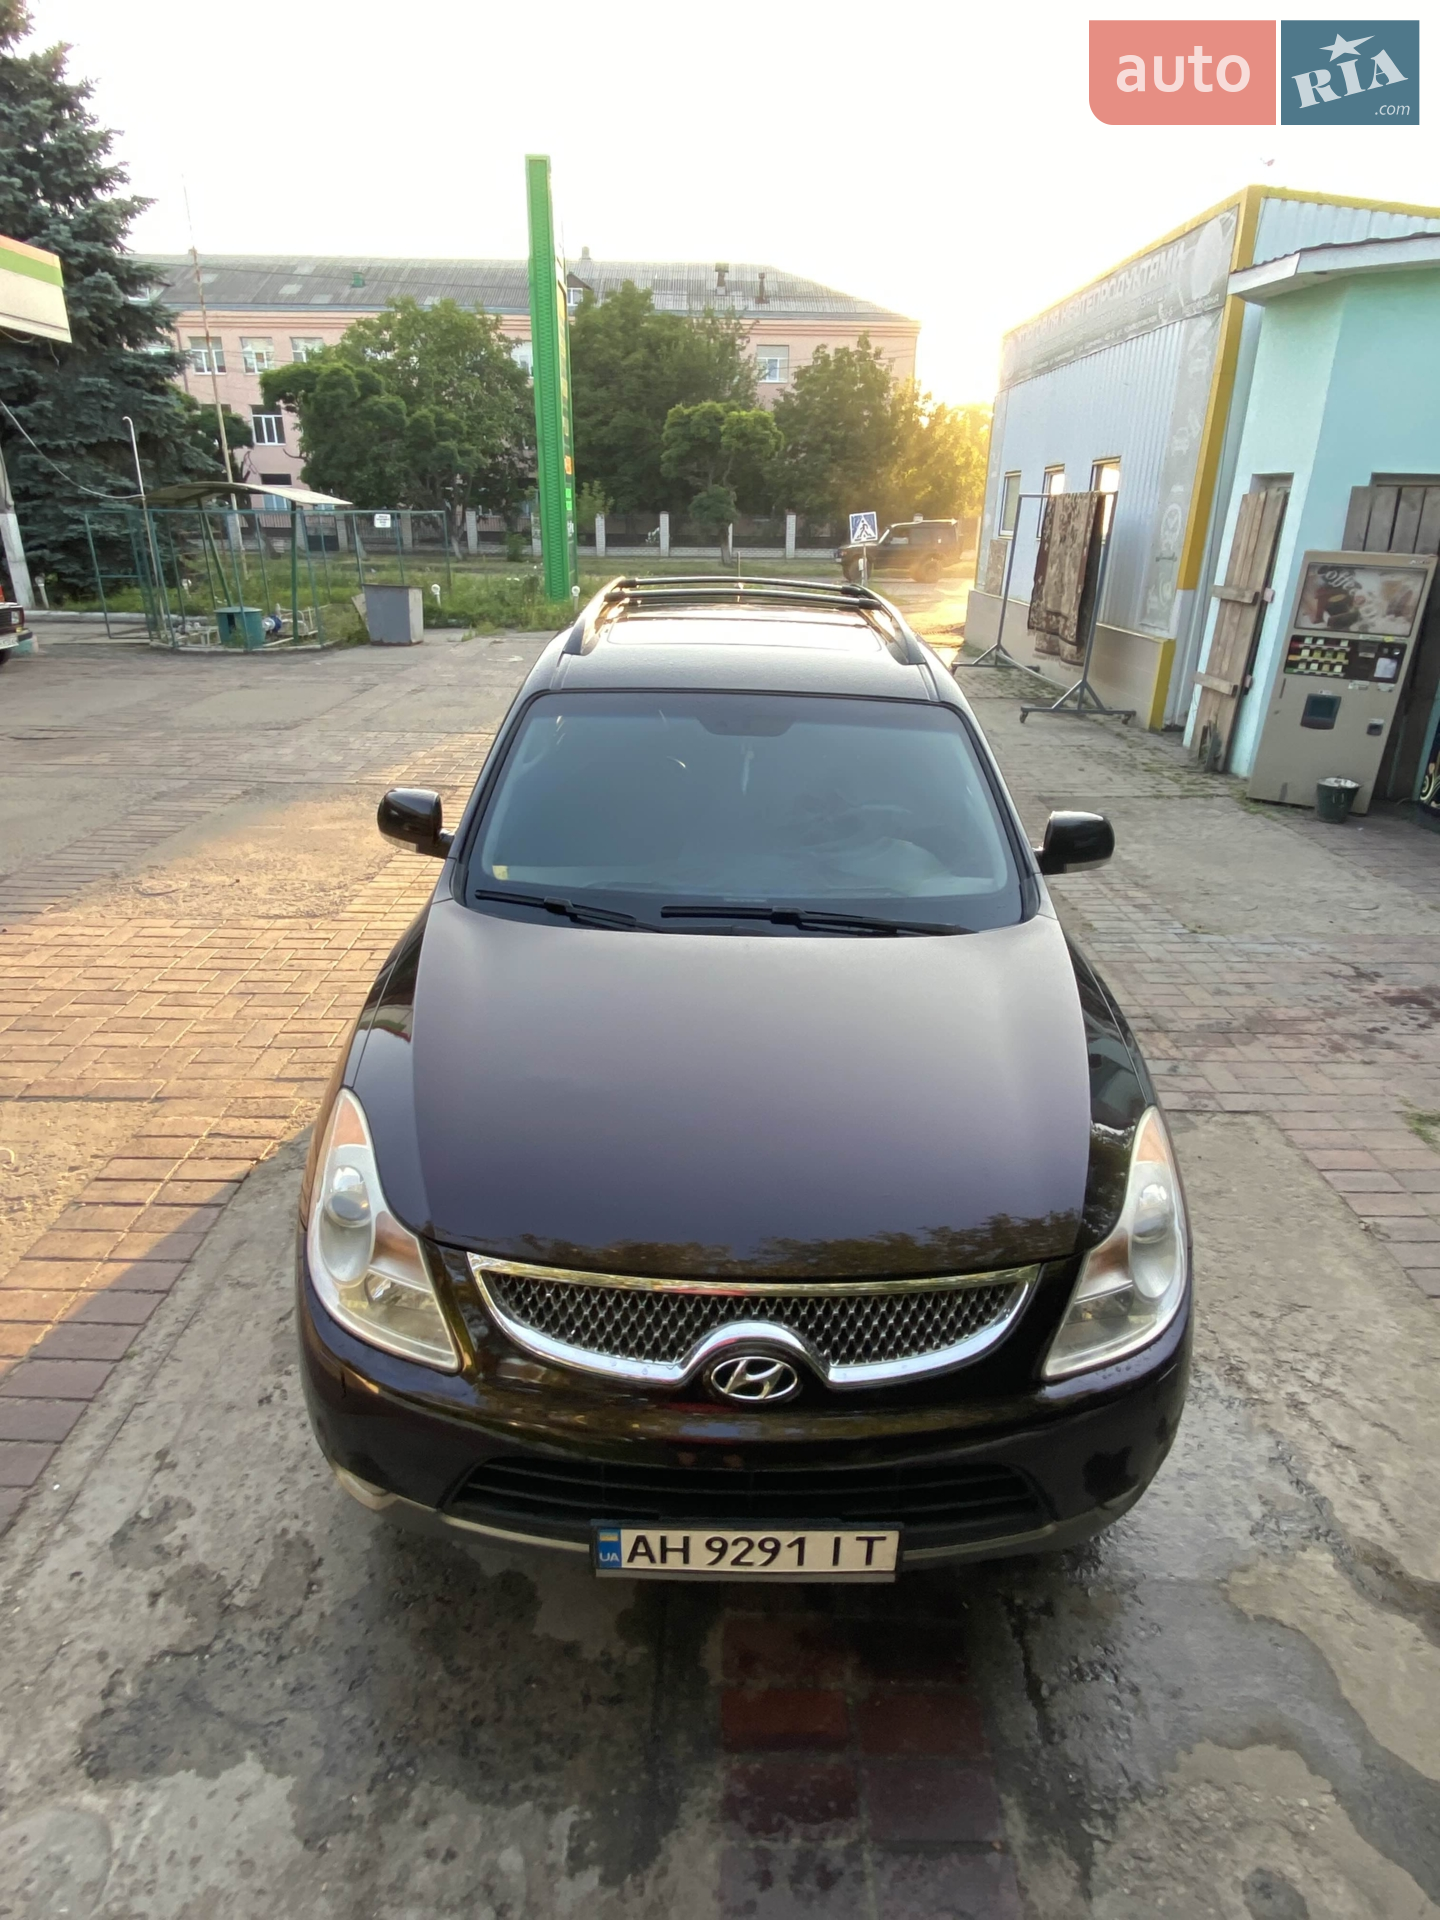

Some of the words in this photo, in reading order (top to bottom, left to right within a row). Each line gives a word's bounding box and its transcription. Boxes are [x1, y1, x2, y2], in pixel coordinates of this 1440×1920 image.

[599, 1552, 620, 1562] UA
[627, 1535, 690, 1564] AH
[705, 1536, 806, 1567] 9291
